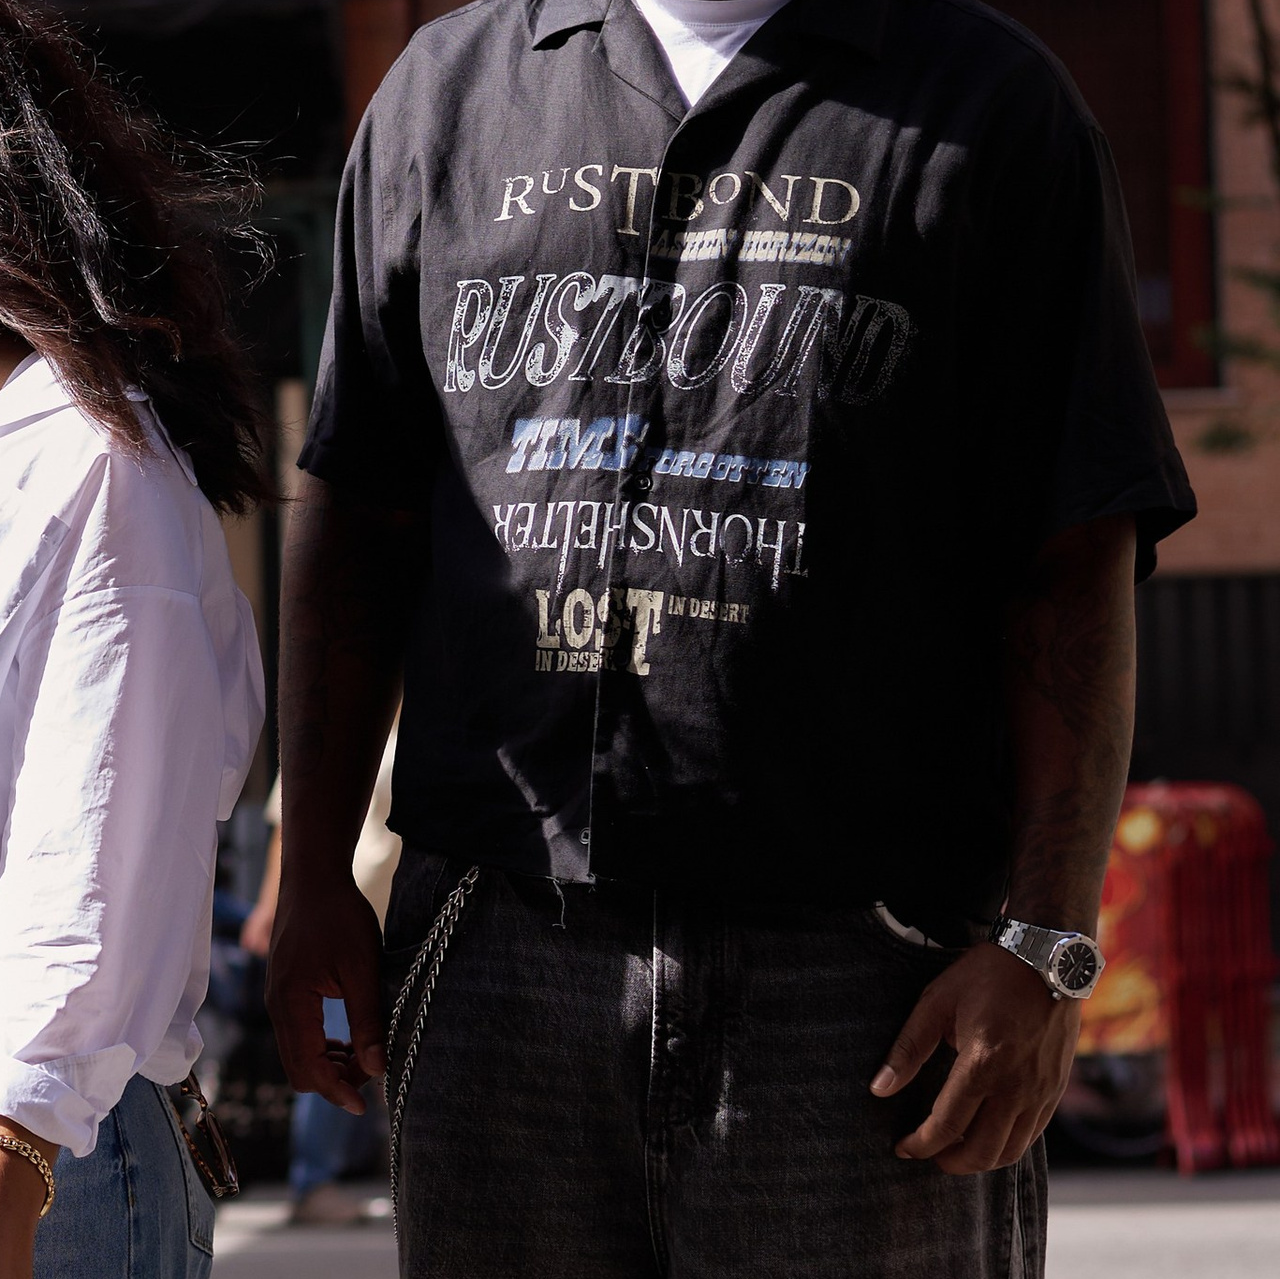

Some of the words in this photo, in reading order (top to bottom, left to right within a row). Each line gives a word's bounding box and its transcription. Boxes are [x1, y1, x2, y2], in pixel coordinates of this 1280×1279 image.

[493, 163, 861, 236] RUSTBOND
[444, 271, 915, 406] RUSTBOUND
[637, 446, 812, 489] FORGOTTEN
[534, 649, 553, 673] IN
[535, 588, 665, 676] LOST
[667, 594, 687, 616] IN
[688, 597, 750, 625] DESERT
